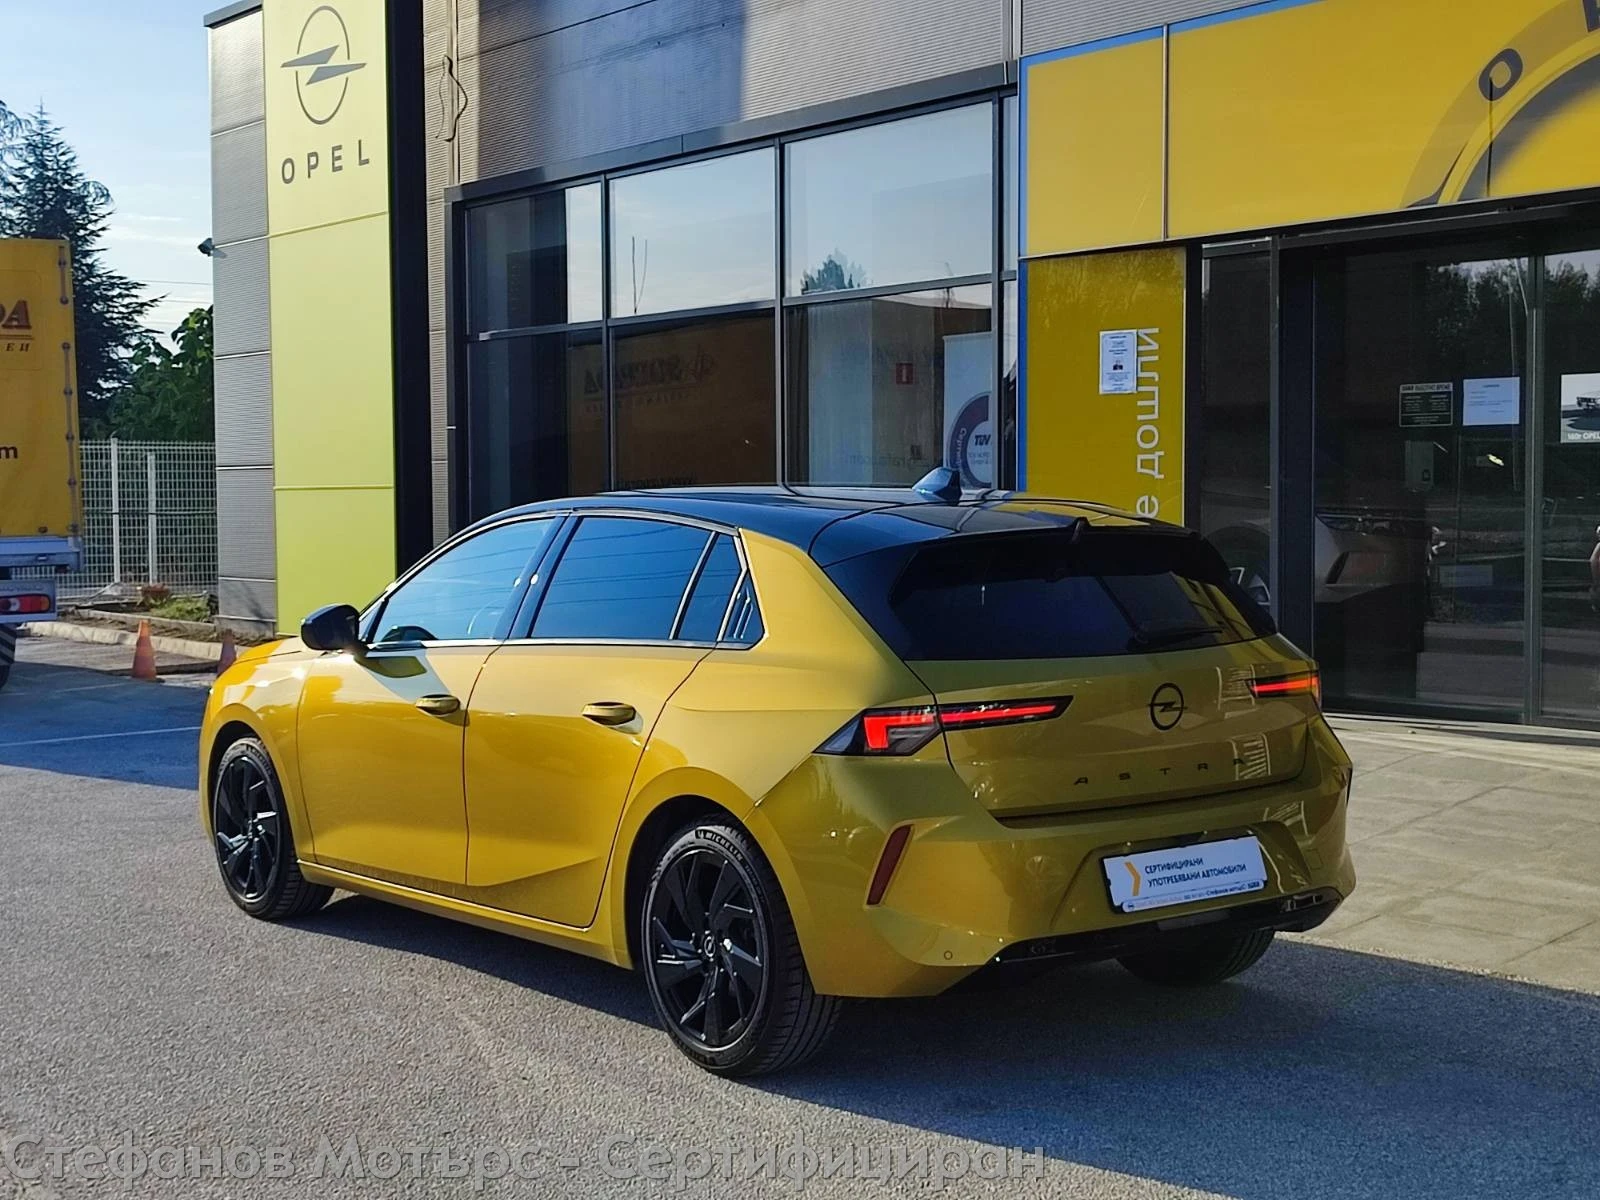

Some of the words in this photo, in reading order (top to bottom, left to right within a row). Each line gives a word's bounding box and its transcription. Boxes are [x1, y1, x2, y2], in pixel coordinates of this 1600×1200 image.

[281, 139, 370, 184] OPEL
[1136, 327, 1164, 479] дошли
[1073, 758, 1247, 786] ASTRA
[705, 831, 744, 862] MICHELIN
[1144, 857, 1204, 875] СЕРТИФИЦИРАНИ
[1147, 872, 1201, 889] УПОТРЕБЯВАНИ
[1201, 863, 1247, 879] АВТОМОБИЛИ
